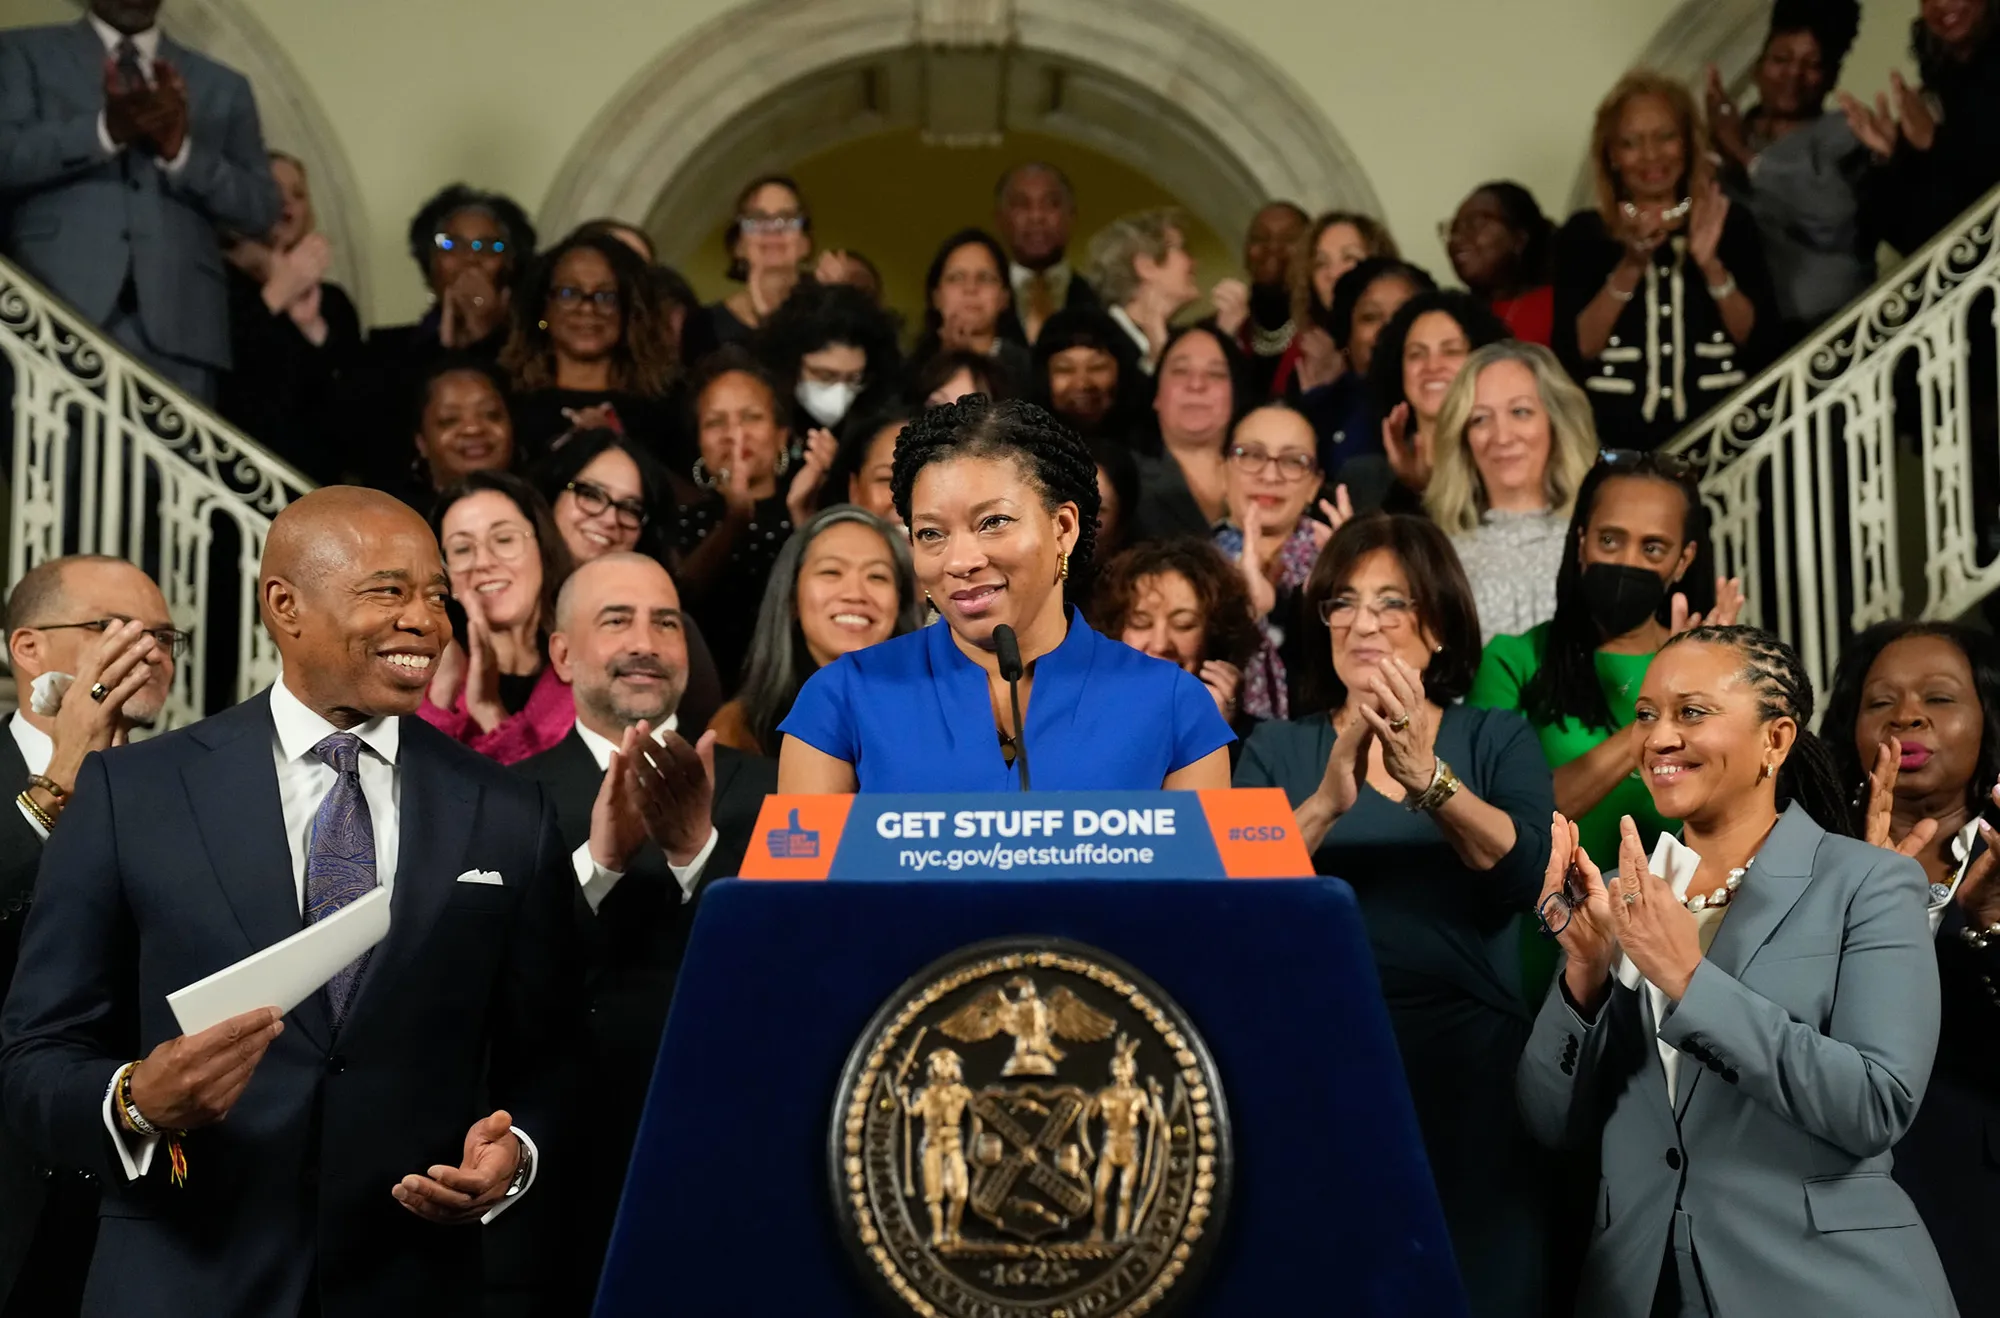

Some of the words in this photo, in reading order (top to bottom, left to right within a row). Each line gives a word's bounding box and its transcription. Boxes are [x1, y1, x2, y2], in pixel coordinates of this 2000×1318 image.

[876, 812, 946, 839] GET
[954, 810, 1064, 838] STUFF
[1073, 808, 1177, 836] DONE
[1228, 826, 1286, 842] #GSD
[900, 842, 1154, 870] nyc.gov/getstuffdone
